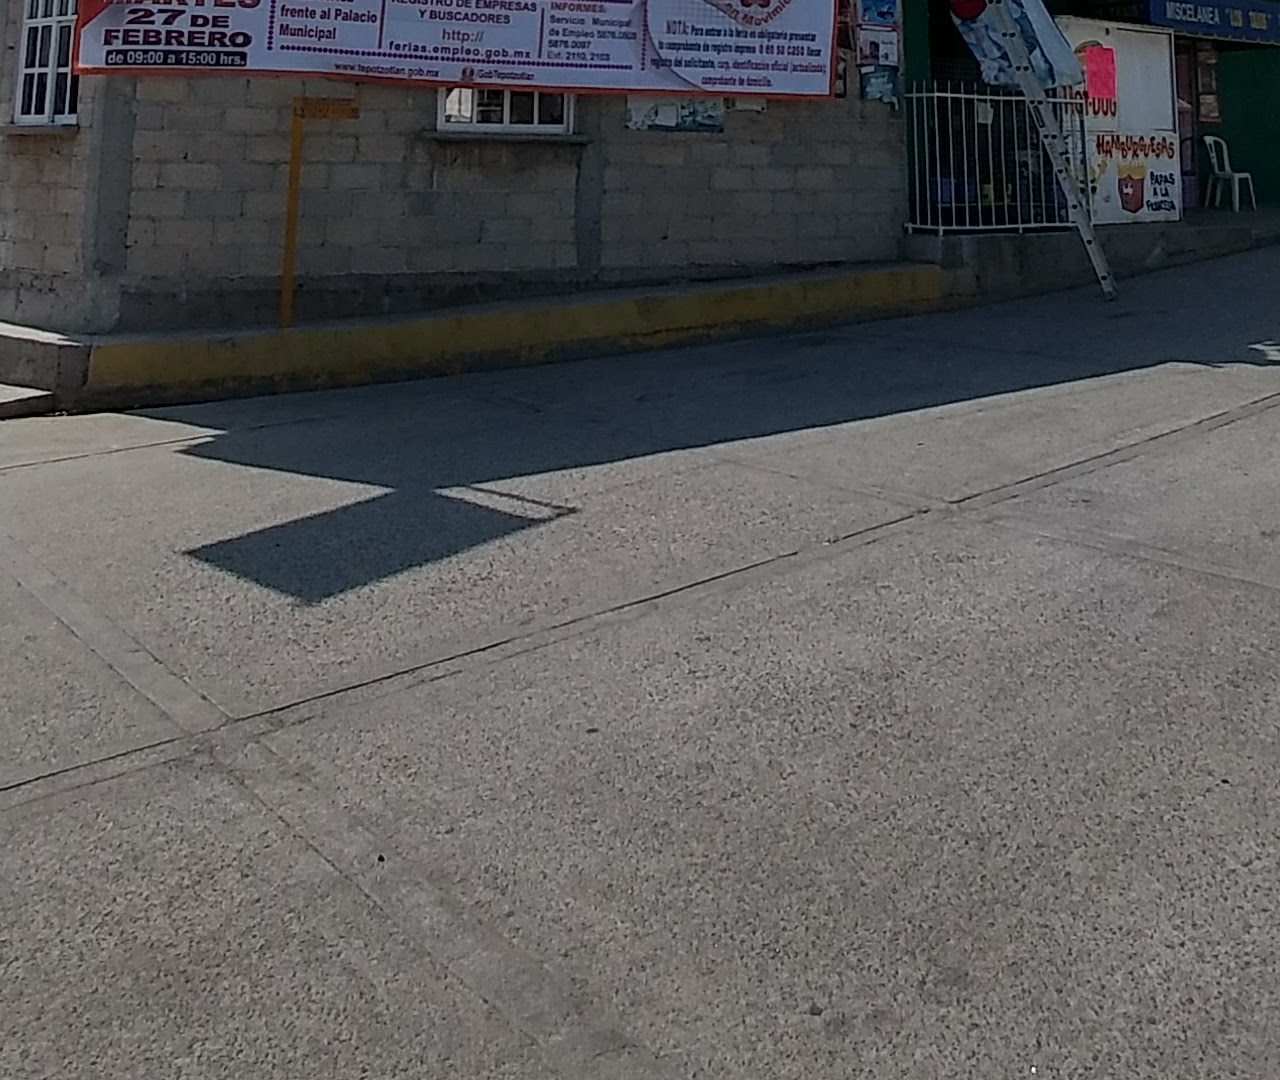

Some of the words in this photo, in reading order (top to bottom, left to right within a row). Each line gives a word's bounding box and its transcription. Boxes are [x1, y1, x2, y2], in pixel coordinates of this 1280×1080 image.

[126, 8, 187, 25] 27
[190, 15, 230, 28] DE
[281, 5, 316, 19] frente
[320, 8, 330, 20] al
[334, 8, 377, 23] Palacio
[418, 9, 427, 18] Y
[429, 10, 510, 24] BUSCADORES
[725, 1, 740, 20] en
[1165, 0, 1220, 25] MISCELANEA
[549, 15, 585, 25] Servicio
[592, 17, 631, 28] Municipal
[103, 29, 252, 47] FEBRERO
[279, 24, 337, 41] Municipal
[442, 28, 484, 43] http://
[548, 28, 560, 36] de
[562, 28, 595, 38] Empleo
[108, 52, 124, 64] de
[127, 52, 164, 64] 09:00
[168, 54, 176, 63] a
[180, 52, 216, 64] 15:00
[220, 53, 245, 65] hrs.
[389, 41, 531, 61] ferias.empleo.gob.mx
[1096, 134, 1175, 159] HAMBURGUESAS
